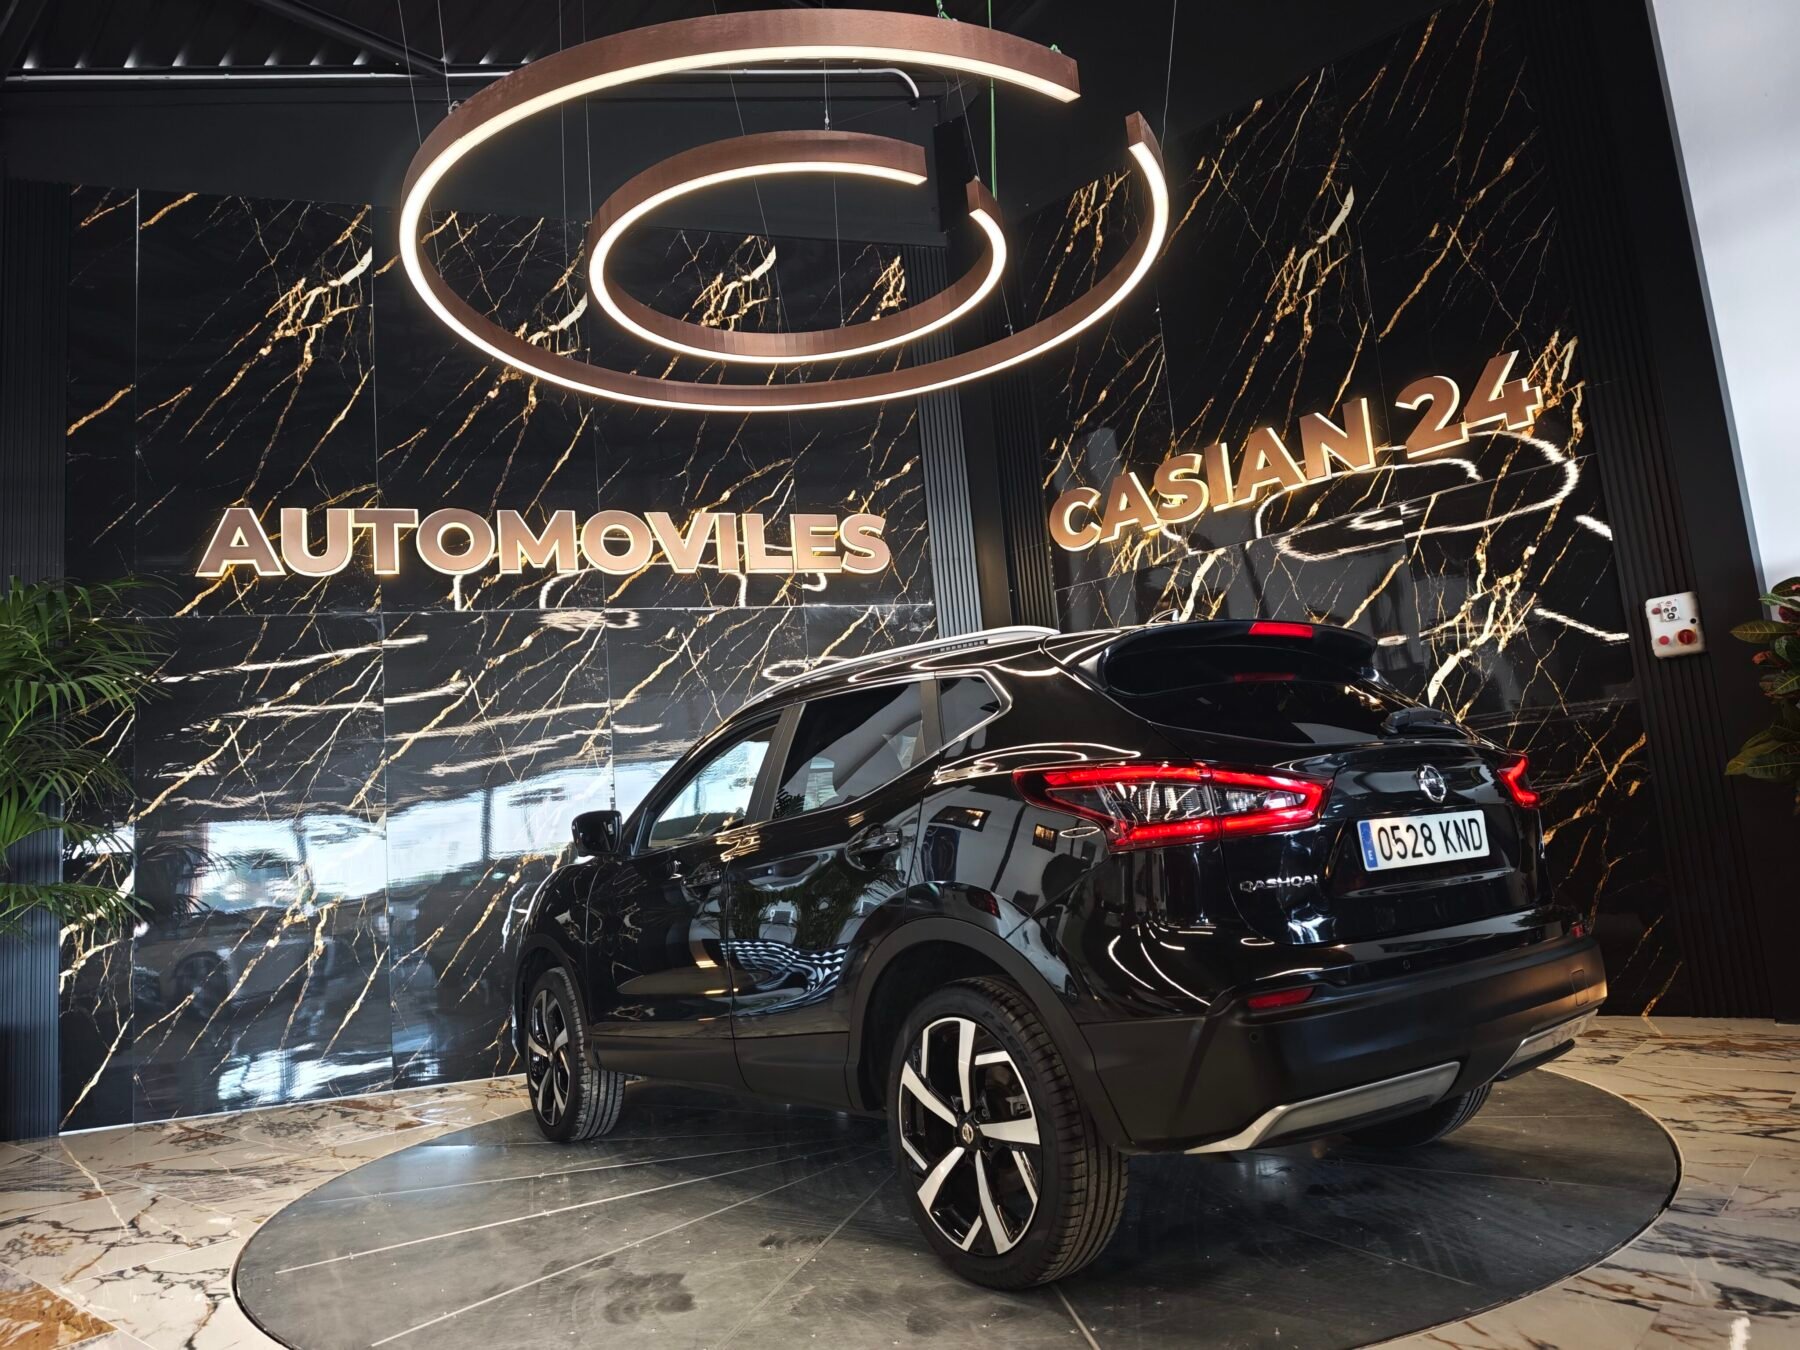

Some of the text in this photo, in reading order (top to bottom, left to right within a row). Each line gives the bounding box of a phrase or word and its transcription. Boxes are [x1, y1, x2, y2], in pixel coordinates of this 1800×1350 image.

[1049, 350, 1543, 552] CASIAN 24
[195, 507, 891, 577] AUTOMOVILES
[1377, 817, 1484, 862] 0528 KND
